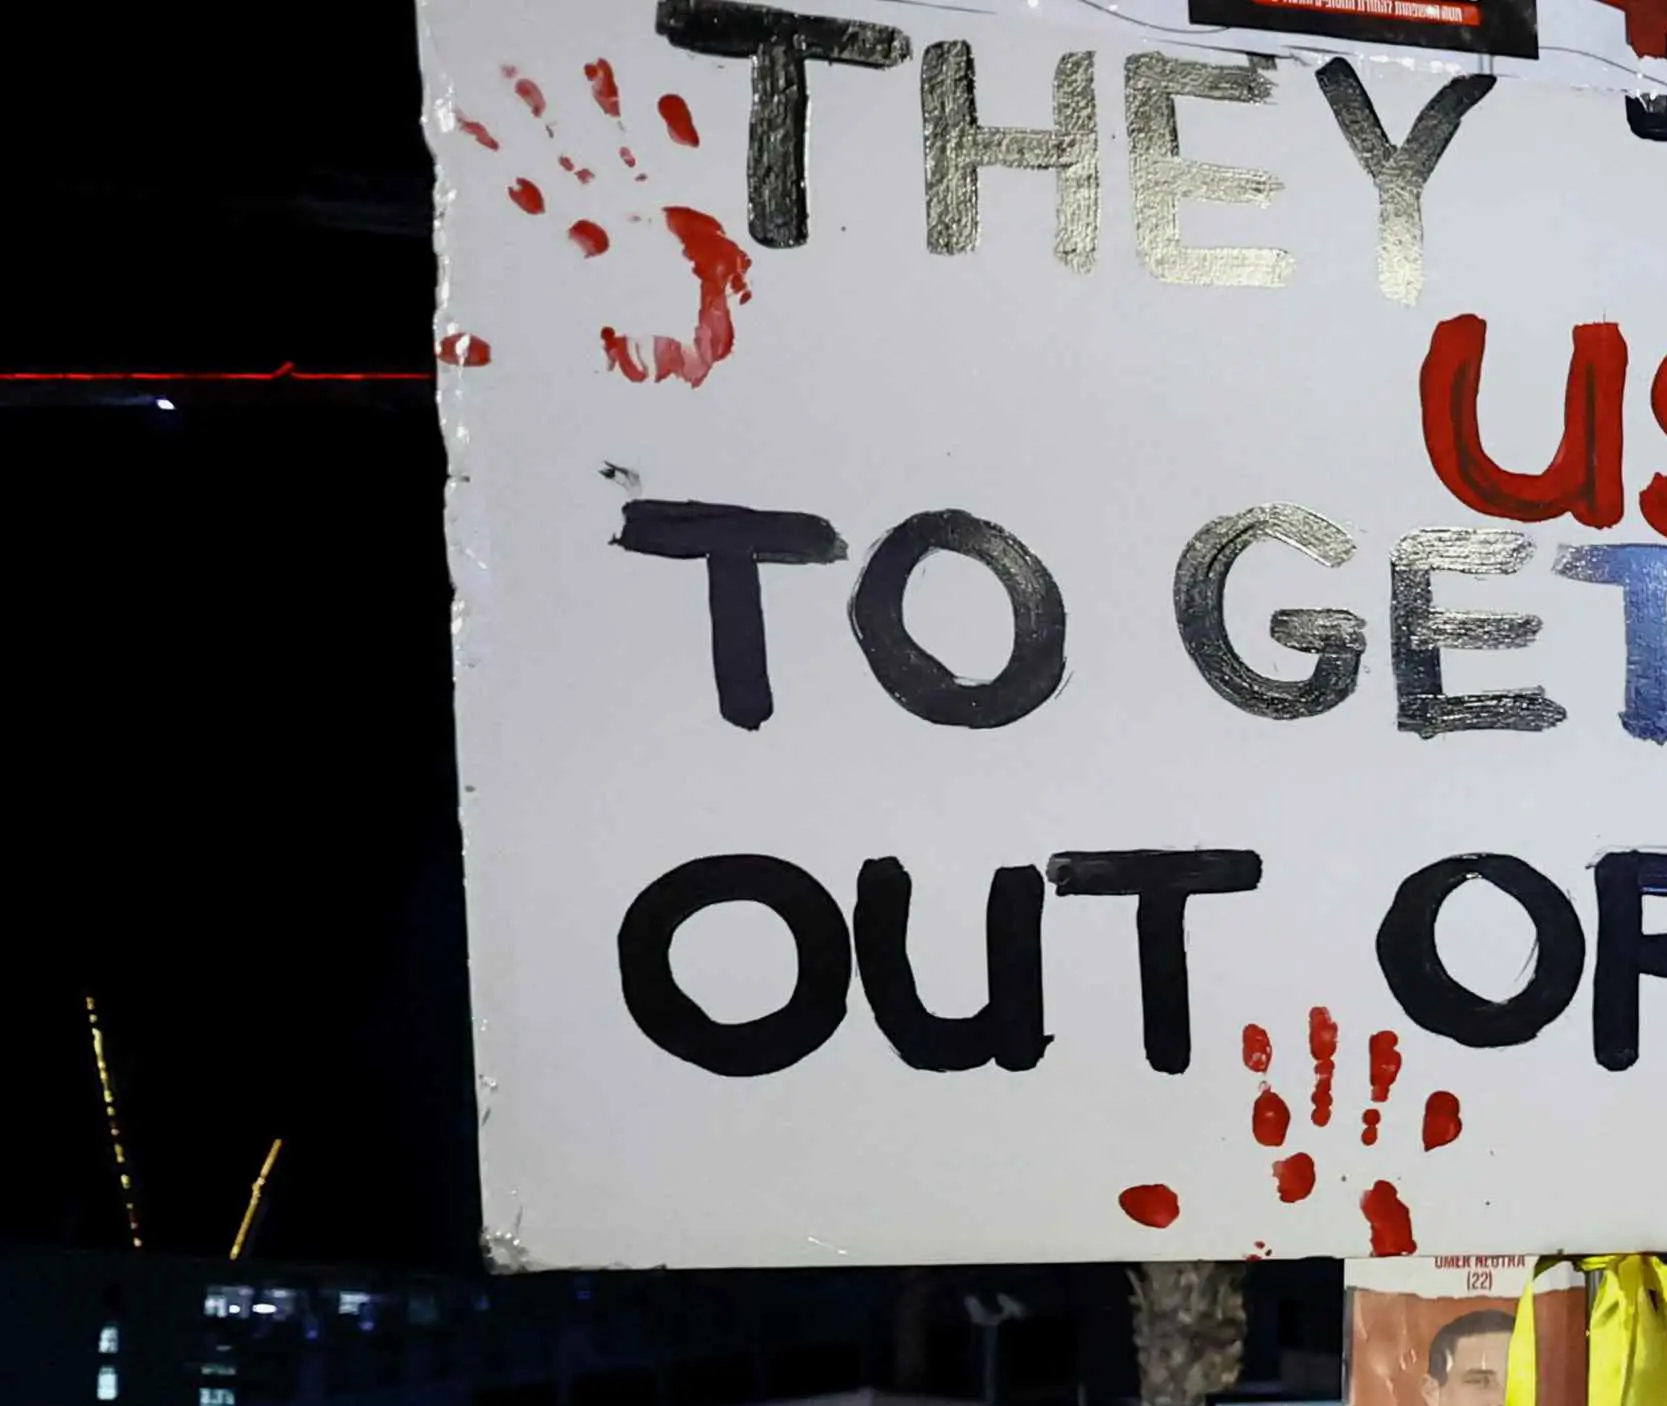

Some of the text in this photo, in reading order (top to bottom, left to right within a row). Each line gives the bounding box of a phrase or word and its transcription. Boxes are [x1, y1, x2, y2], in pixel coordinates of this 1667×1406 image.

[656, 0, 1498, 307] THEY
[609, 500, 1067, 729] TO
[617, 849, 1263, 1077] OUT
[1467, 1270, 1493, 1292] (22)
